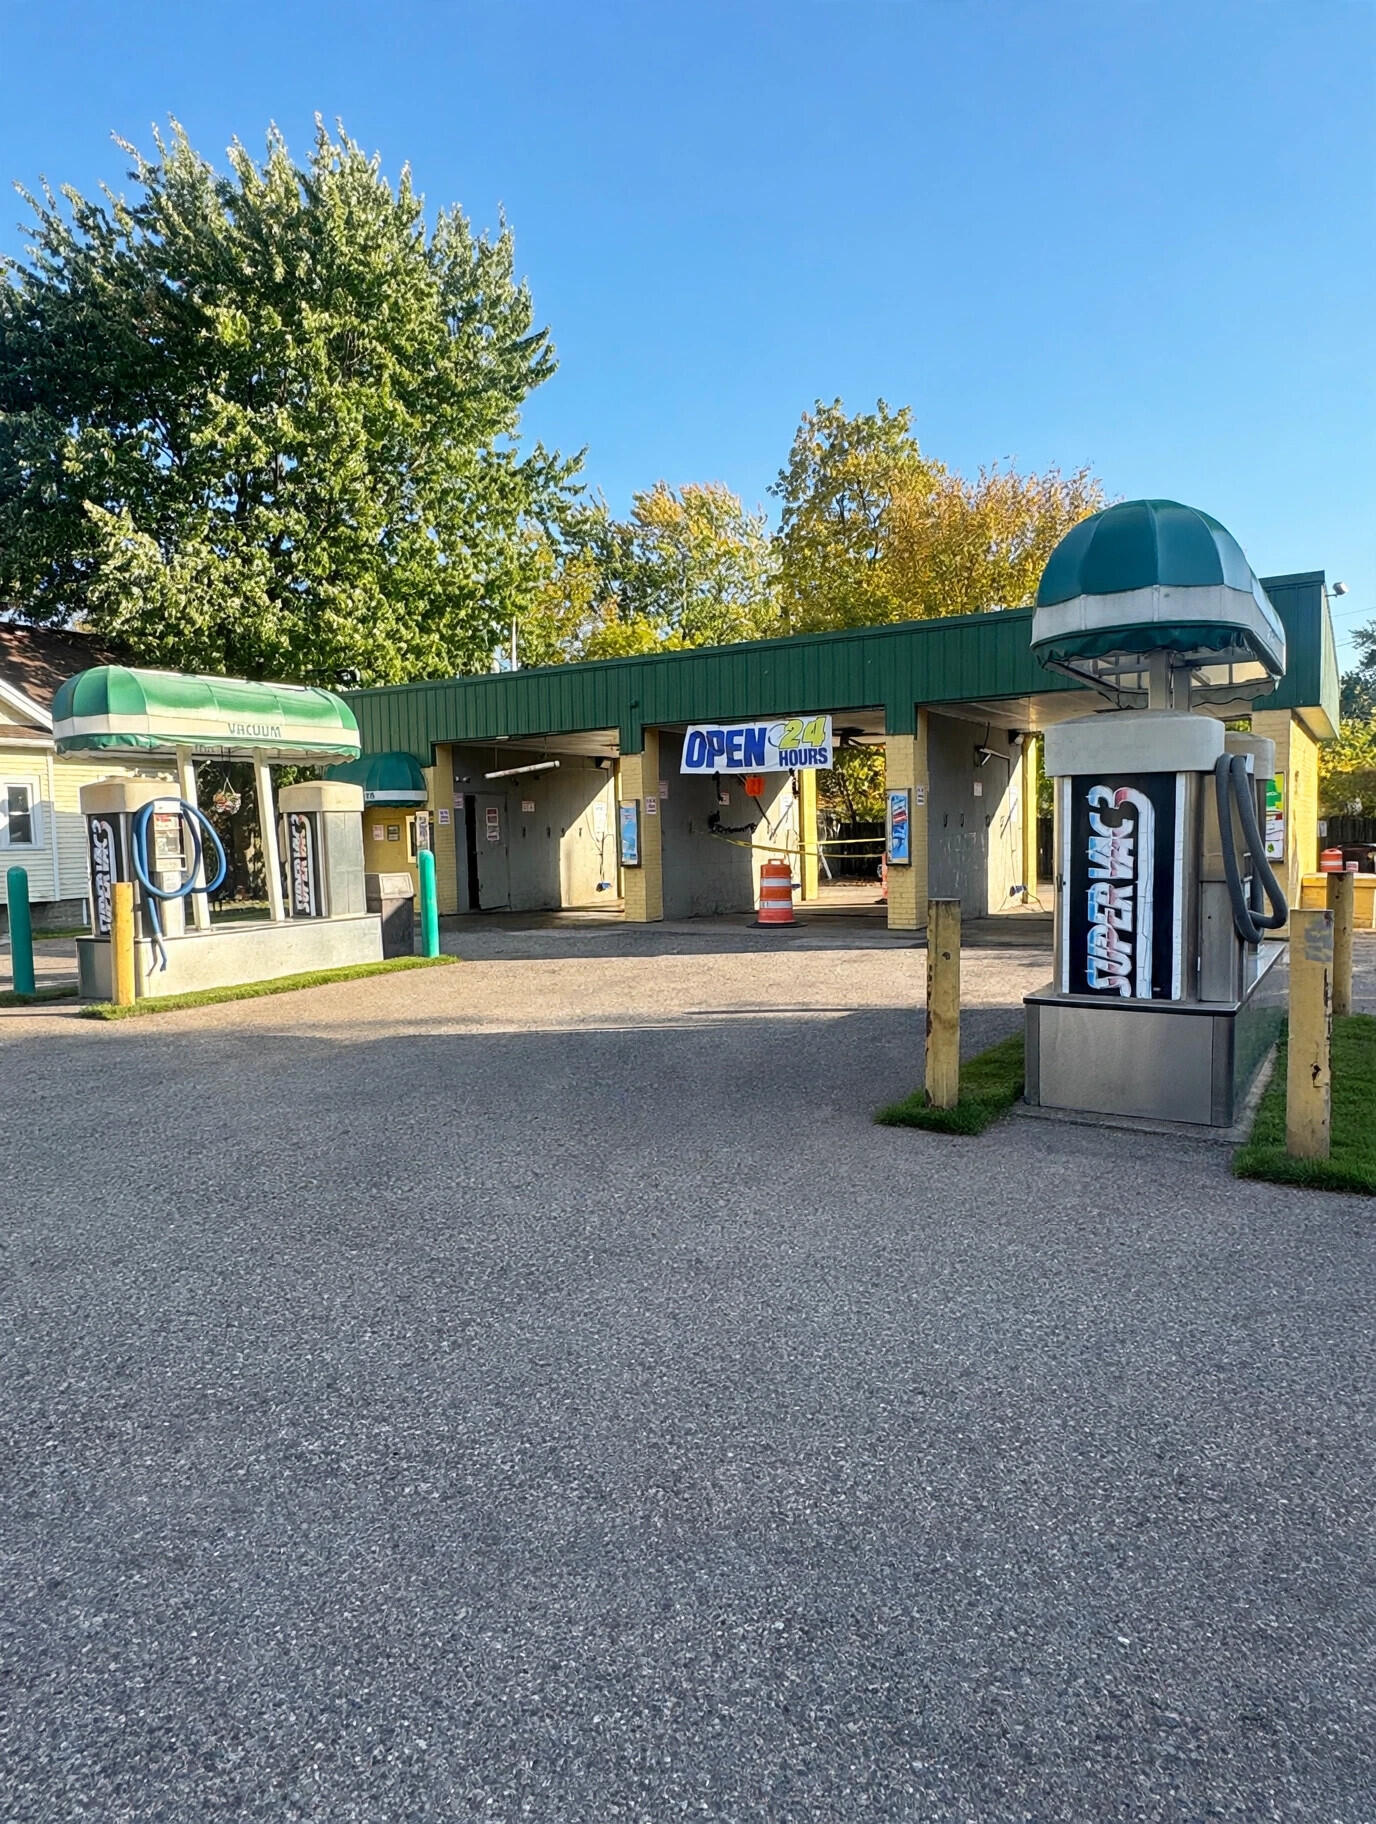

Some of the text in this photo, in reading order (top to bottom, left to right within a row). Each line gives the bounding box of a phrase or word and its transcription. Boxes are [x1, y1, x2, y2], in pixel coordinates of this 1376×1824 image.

[227, 722, 282, 738] VACUUM
[778, 716, 827, 749] 24
[685, 727, 767, 768] OPEN
[778, 747, 828, 767] HOURS
[1086, 881, 1134, 998] SUPER
